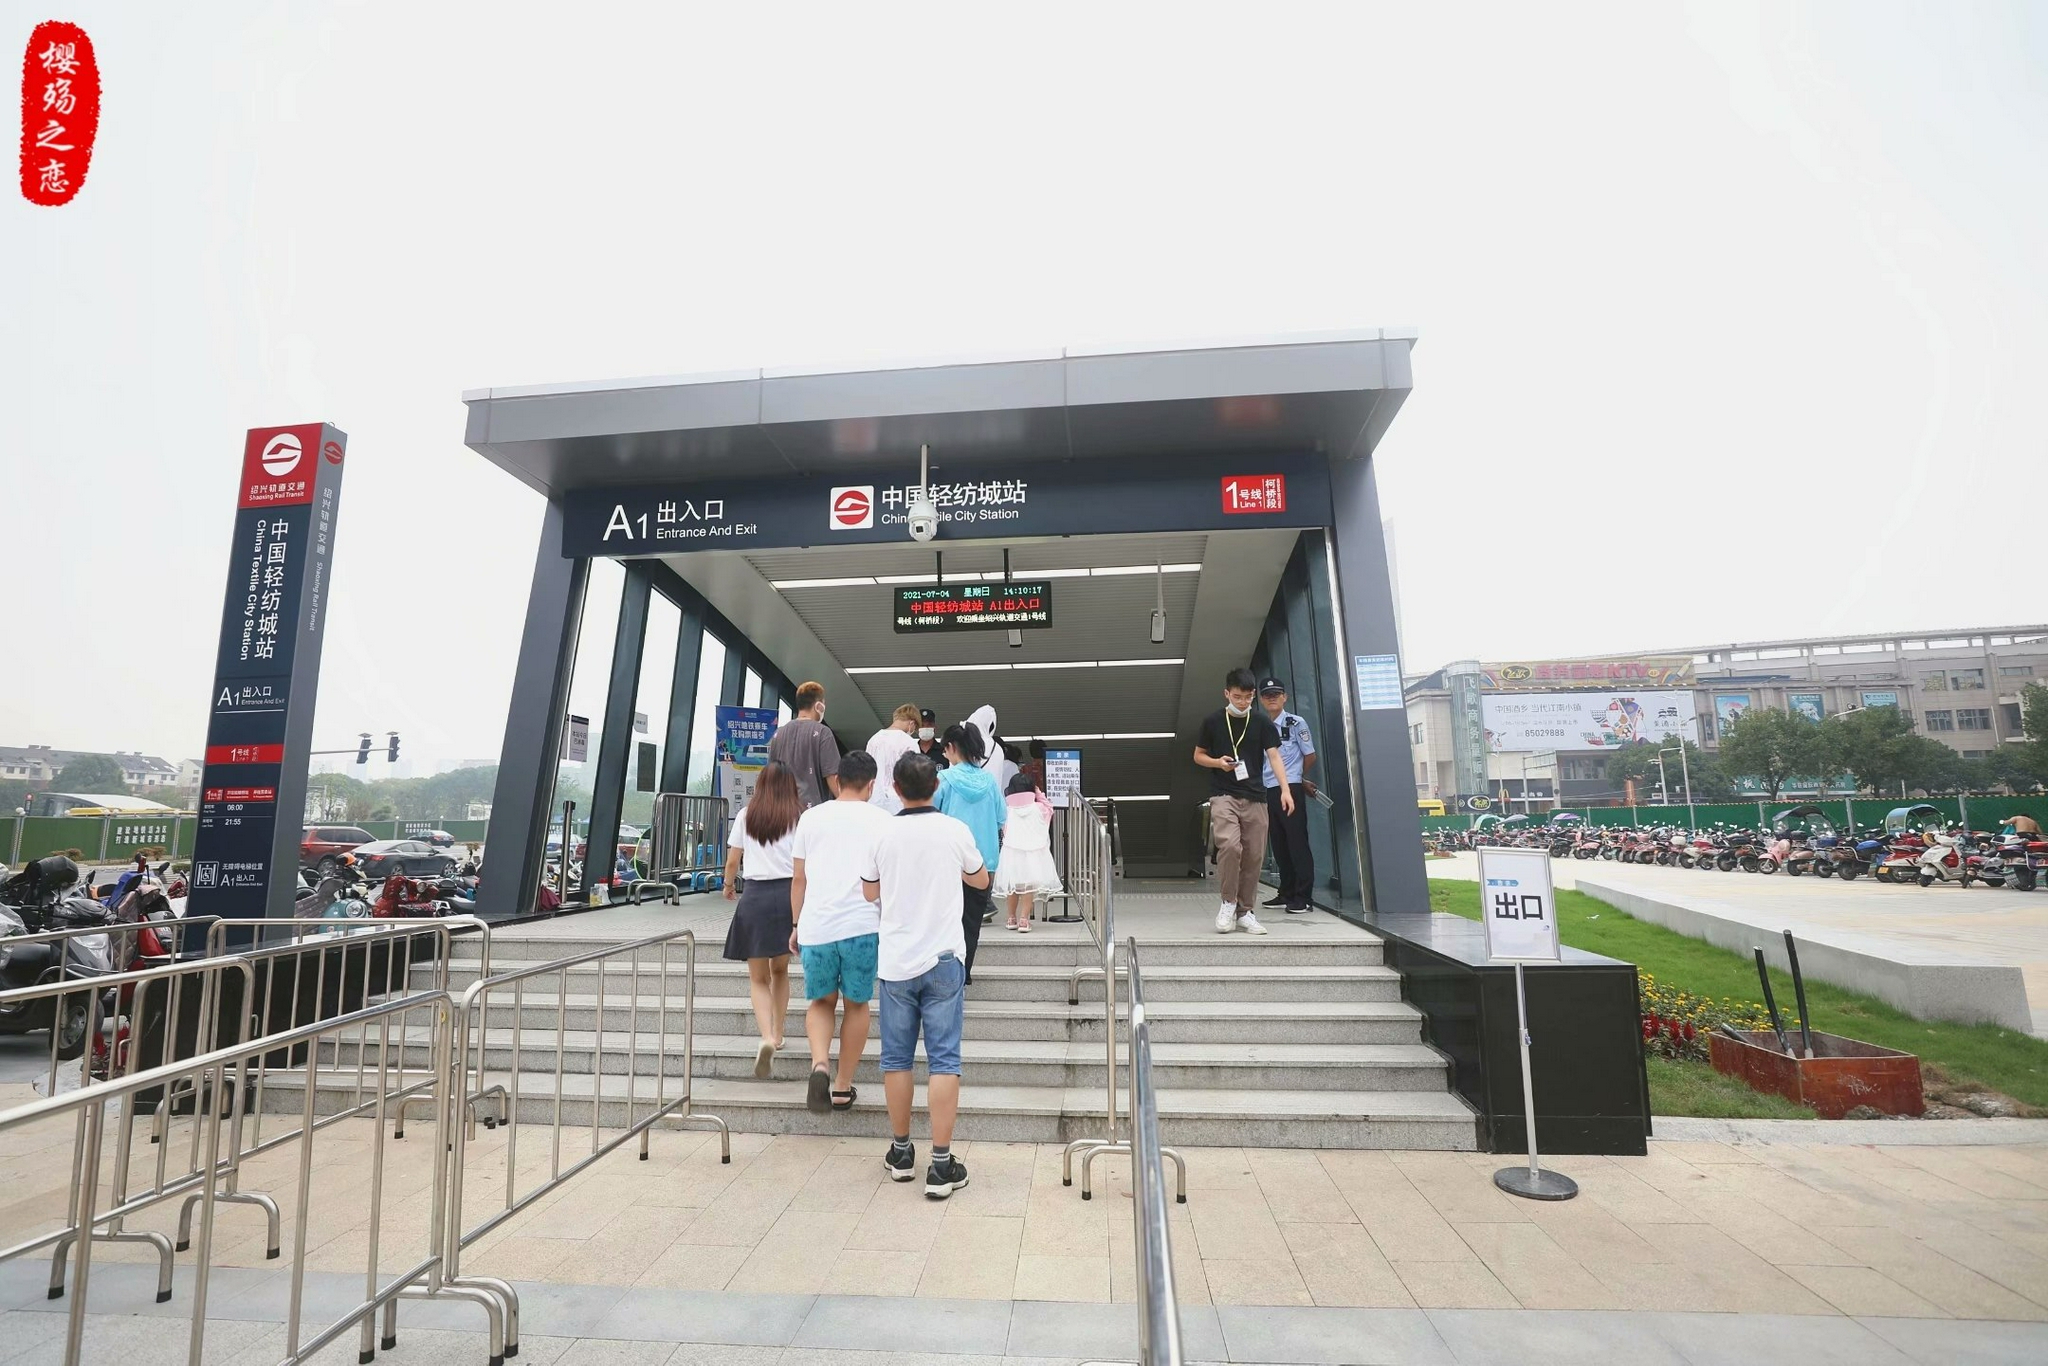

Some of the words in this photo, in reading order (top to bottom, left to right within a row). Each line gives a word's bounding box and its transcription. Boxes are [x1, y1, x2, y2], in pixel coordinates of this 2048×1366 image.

[250, 481, 306, 495] 绍兴轨道交通
[286, 490, 305, 498] Transit
[1265, 479, 1277, 509] 柯桥段
[657, 499, 724, 524] 出入口
[1258, 500, 1263, 508] 1
[602, 504, 648, 541] A1
[881, 512, 908, 525] Chin
[954, 510, 976, 523] City
[979, 508, 1019, 520] Station
[254, 520, 267, 553] China
[656, 526, 707, 540] Entrance
[708, 524, 732, 536] And
[735, 523, 758, 534] Exit
[249, 554, 262, 592] Textile
[254, 518, 289, 660] 中国轻纺城站
[903, 590, 950, 600] 2021-07-04
[963, 586, 990, 598] 星期日
[1004, 586, 1042, 596] 14:10:17
[244, 593, 257, 617] City
[911, 602, 984, 614] 中国轻纺城站
[240, 619, 254, 661] Station
[217, 686, 240, 706] A1
[242, 685, 272, 698] 出入口
[731, 729, 765, 740] 及购票指引
[224, 818, 241, 826] 21:55
[221, 862, 264, 871] 无障碍电梯位置
[220, 873, 235, 887] A1
[235, 873, 255, 882] 出入口
[1495, 892, 1543, 920] 出口
